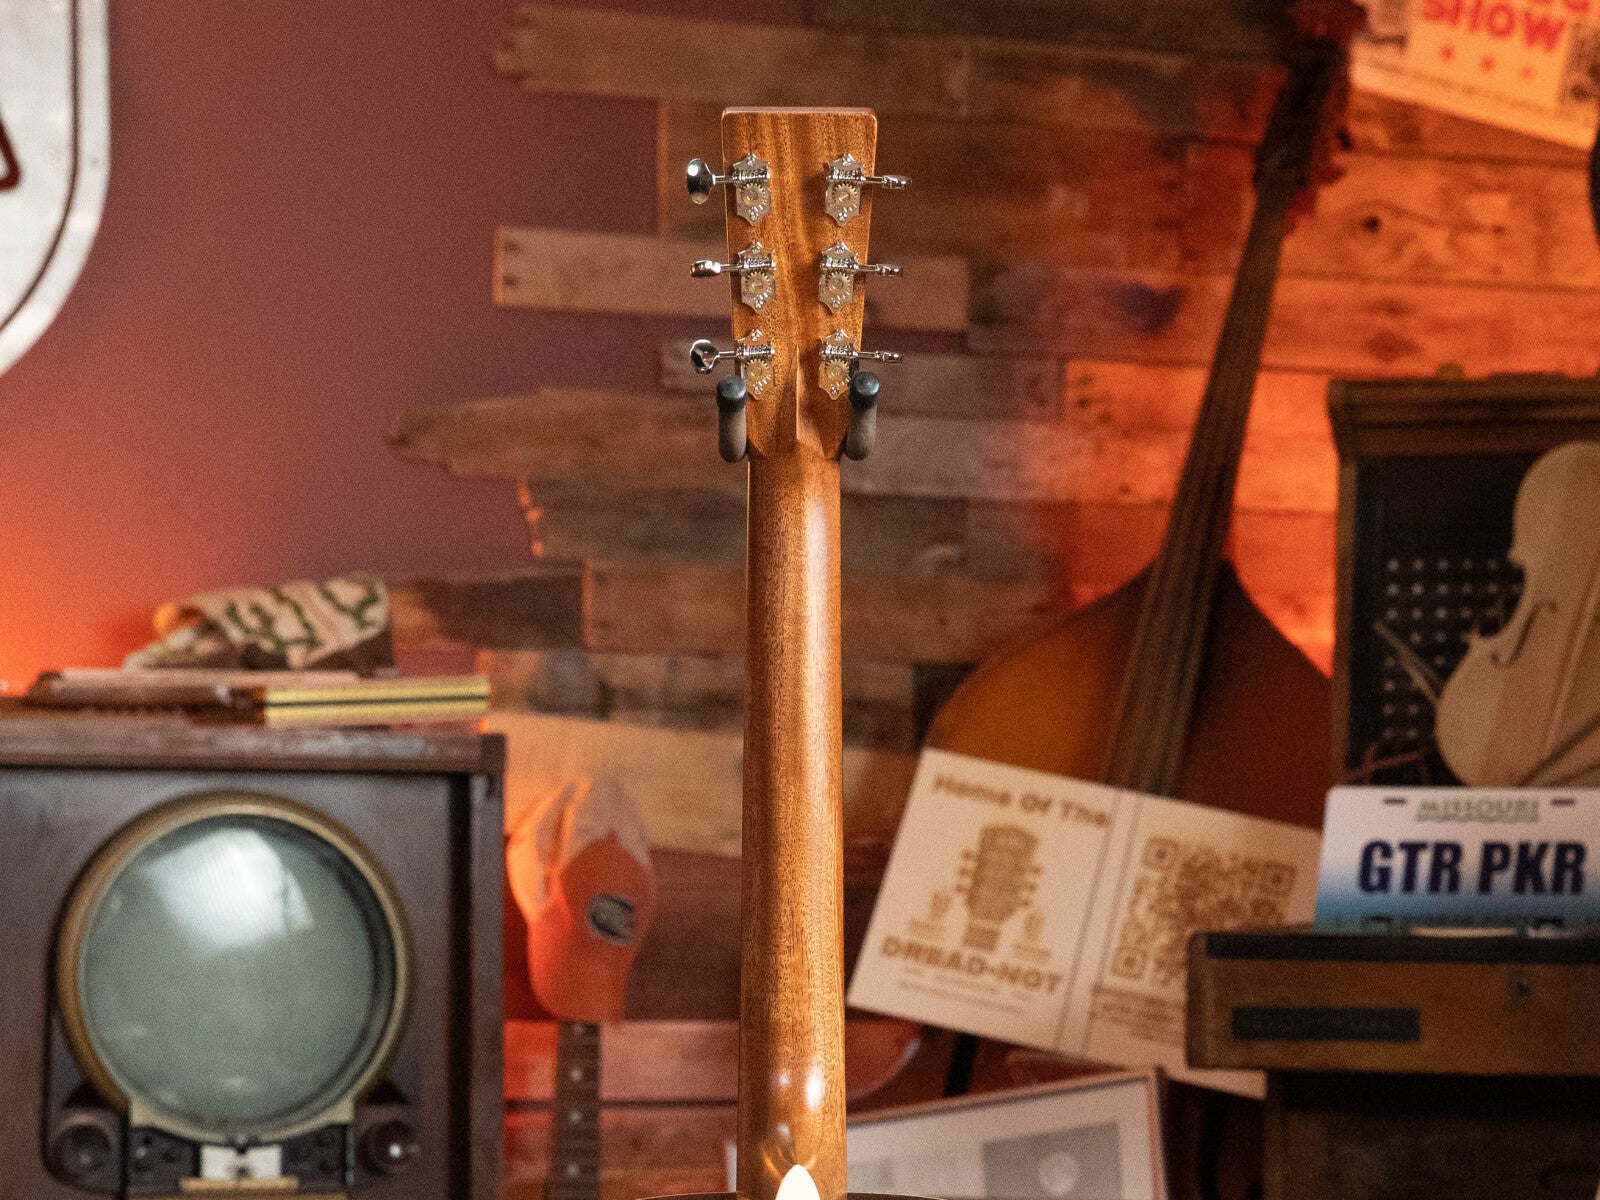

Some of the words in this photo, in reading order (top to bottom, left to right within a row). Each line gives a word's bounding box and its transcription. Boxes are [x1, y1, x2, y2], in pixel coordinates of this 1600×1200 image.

[1417, 796, 1540, 822] MISSOURI
[1358, 840, 1463, 894] GTR
[1478, 841, 1587, 895] PKR
[880, 935, 1064, 994] DREAD-NOT
